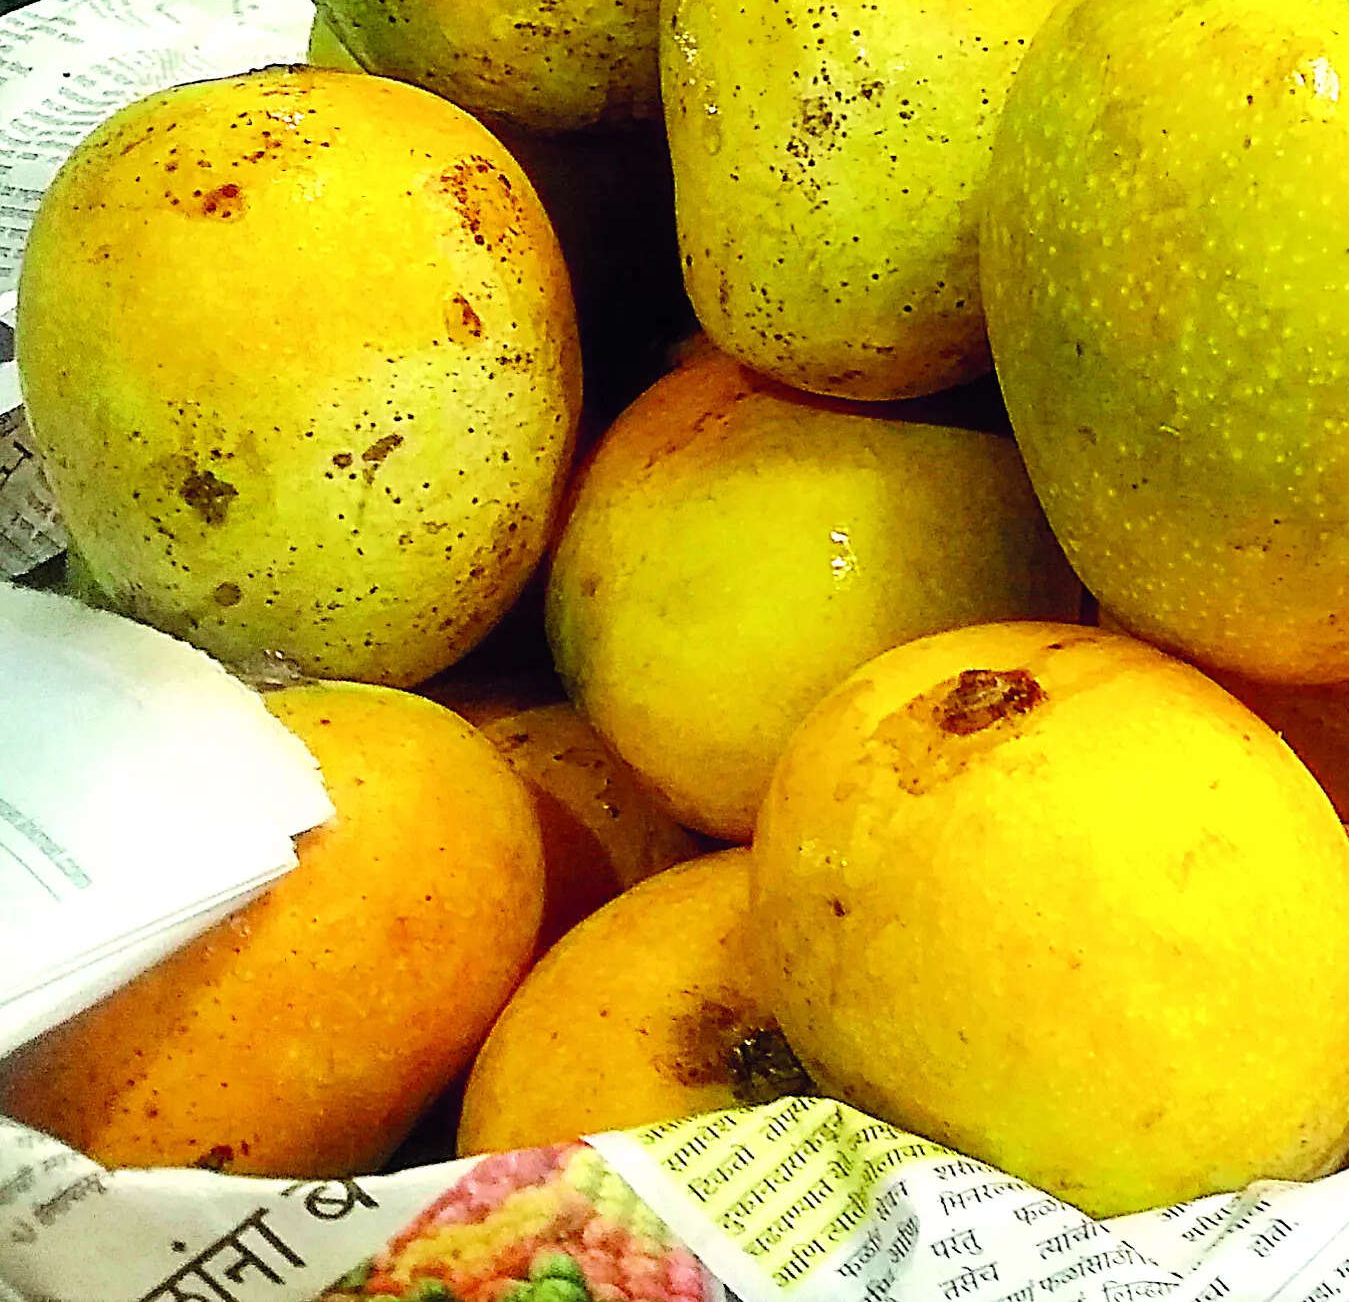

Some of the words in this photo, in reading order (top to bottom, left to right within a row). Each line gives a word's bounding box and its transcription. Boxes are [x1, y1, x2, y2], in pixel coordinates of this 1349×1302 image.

[661, 1107, 737, 1172] समावेश
[847, 1115, 898, 1152] त्यामु
[718, 1106, 844, 1235] दुकानदारांकडून
[772, 1239, 827, 1287] आणि
[928, 1228, 984, 1259] परंतु
[937, 1261, 999, 1300] तसेच
